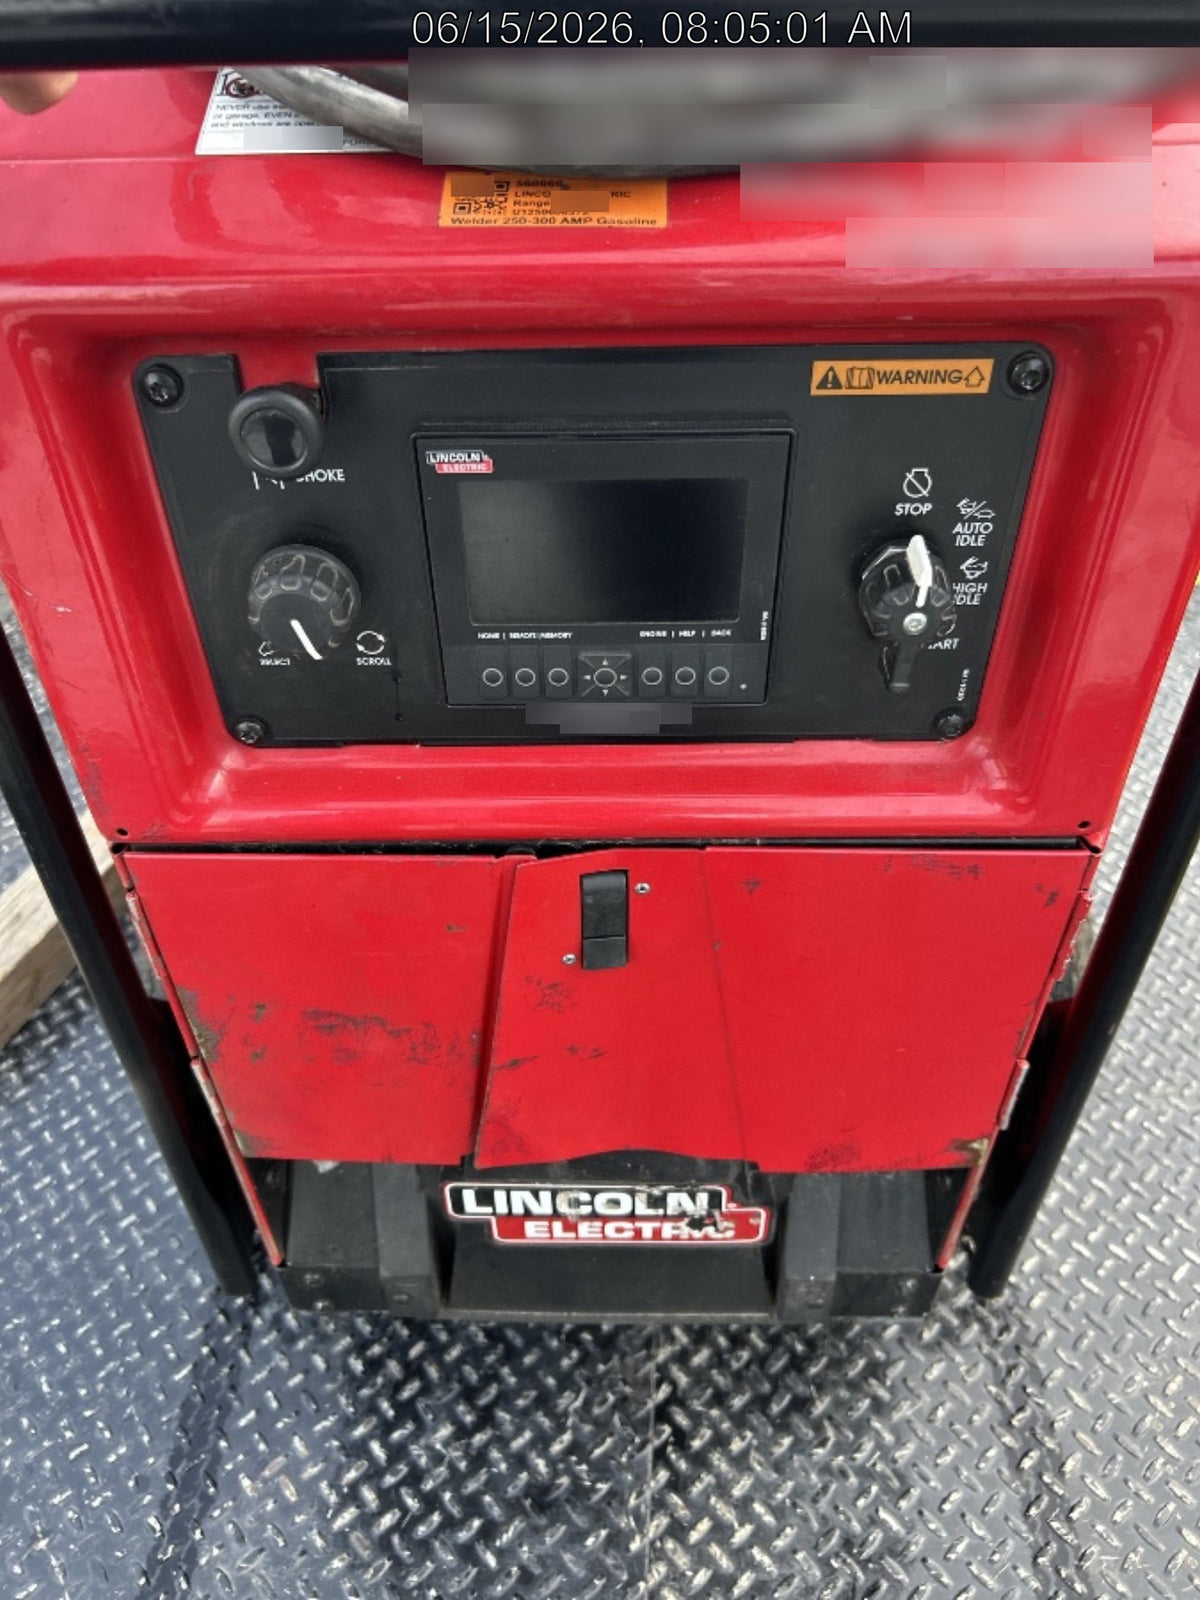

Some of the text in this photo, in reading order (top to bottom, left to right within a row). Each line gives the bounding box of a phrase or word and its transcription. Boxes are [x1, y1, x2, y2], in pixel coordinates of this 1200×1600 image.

[513, 199, 550, 209] Range
[451, 216, 658, 226] Welder 250-300 AMP Gasoline
[876, 368, 963, 386] WARNING
[429, 451, 481, 464] LINCOLN
[894, 502, 932, 516] STOP
[952, 521, 993, 535] AUTO
[955, 534, 987, 547] IDLE
[678, 631, 697, 639] HELP
[927, 637, 960, 651] ART
[355, 657, 392, 666] SCROLL
[462, 1187, 710, 1216] LINCOLN
[524, 1220, 736, 1240] ELECTRC
